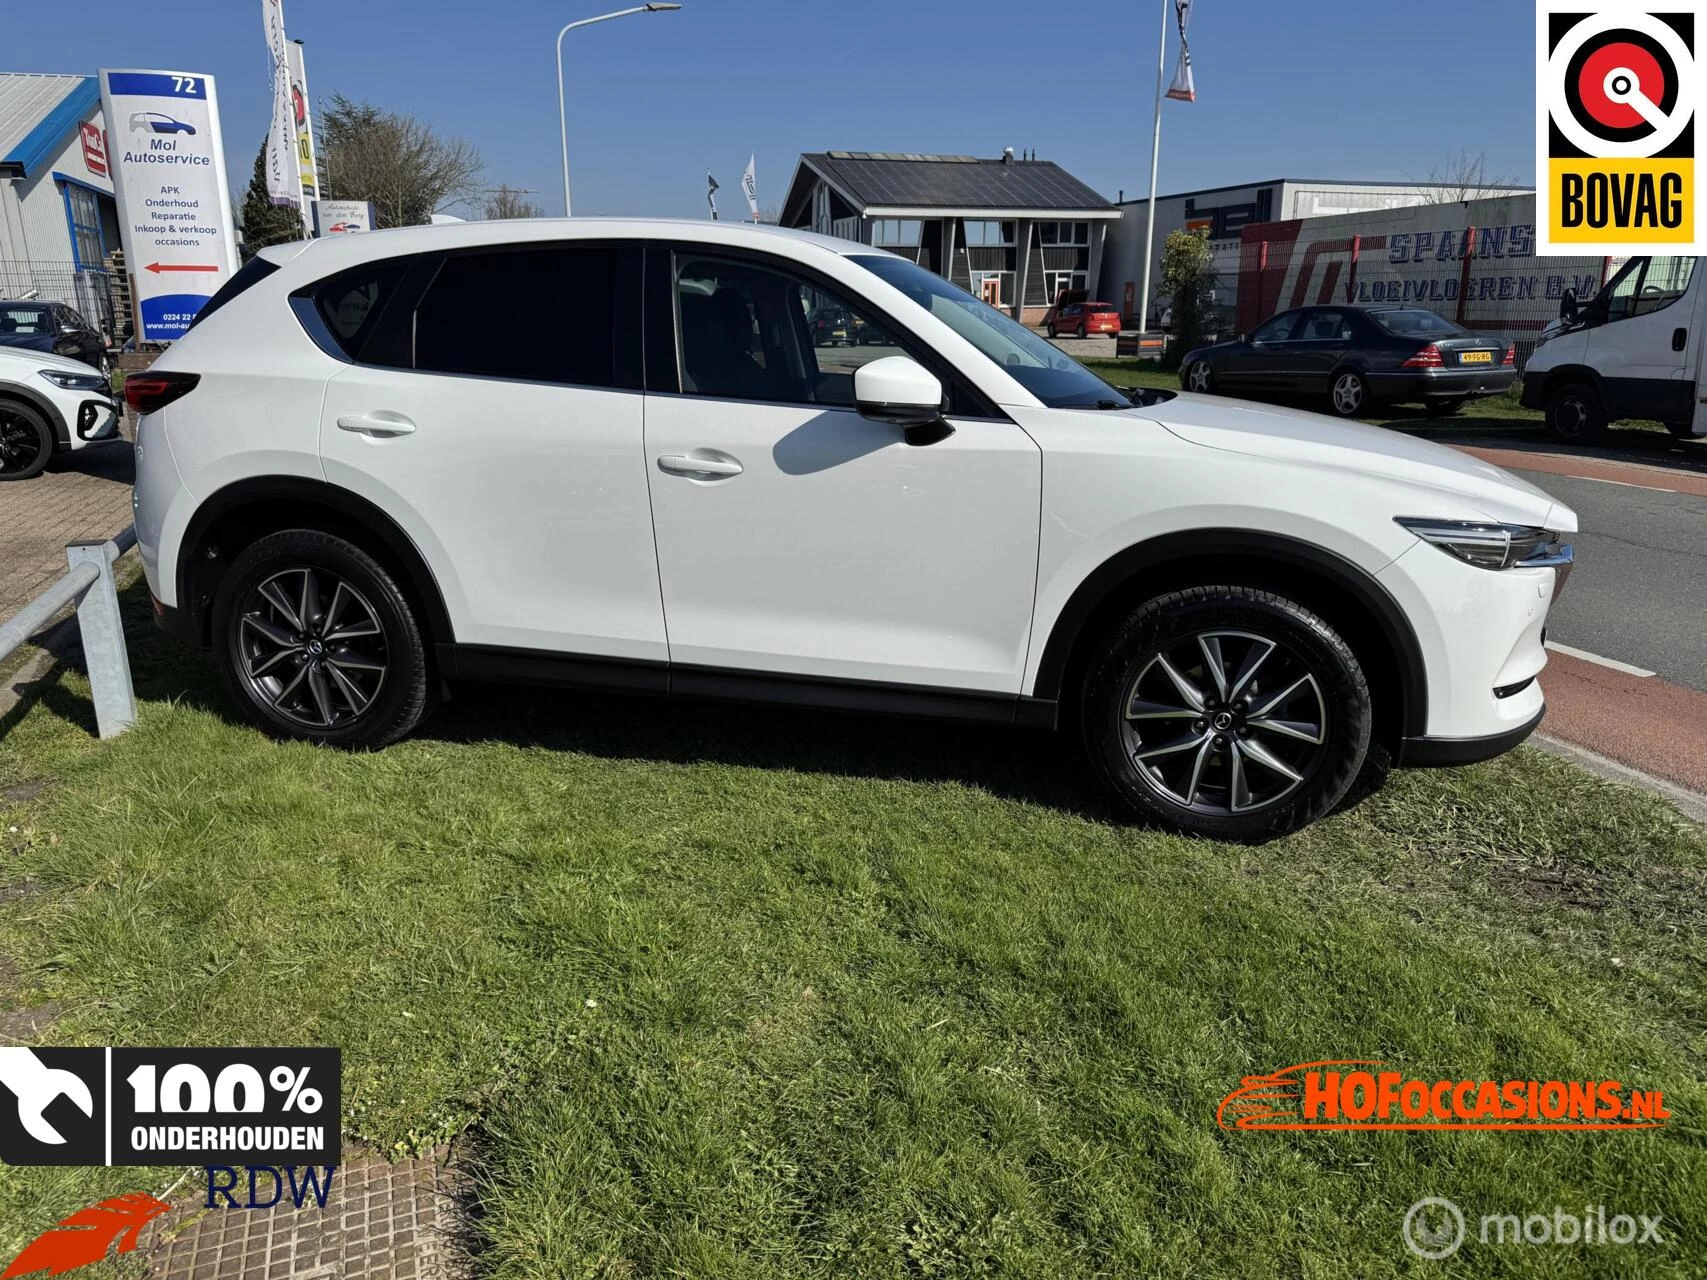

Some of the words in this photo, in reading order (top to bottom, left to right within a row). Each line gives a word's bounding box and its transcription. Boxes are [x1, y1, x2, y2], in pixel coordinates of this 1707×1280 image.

[171, 76, 197, 94] 72
[150, 139, 177, 151] Mol
[123, 152, 210, 166] Autoservice
[160, 186, 180, 195] APK
[145, 198, 199, 208] Onderhoud
[151, 211, 197, 221] Reparatie
[134, 224, 166, 234] Inkoop
[168, 224, 176, 233] &
[179, 225, 217, 235] verkoop
[155, 237, 200, 247] occasions
[1545, 274, 1597, 301] BV.
[163, 313, 180, 321] 0224
[182, 313, 191, 321] 22
